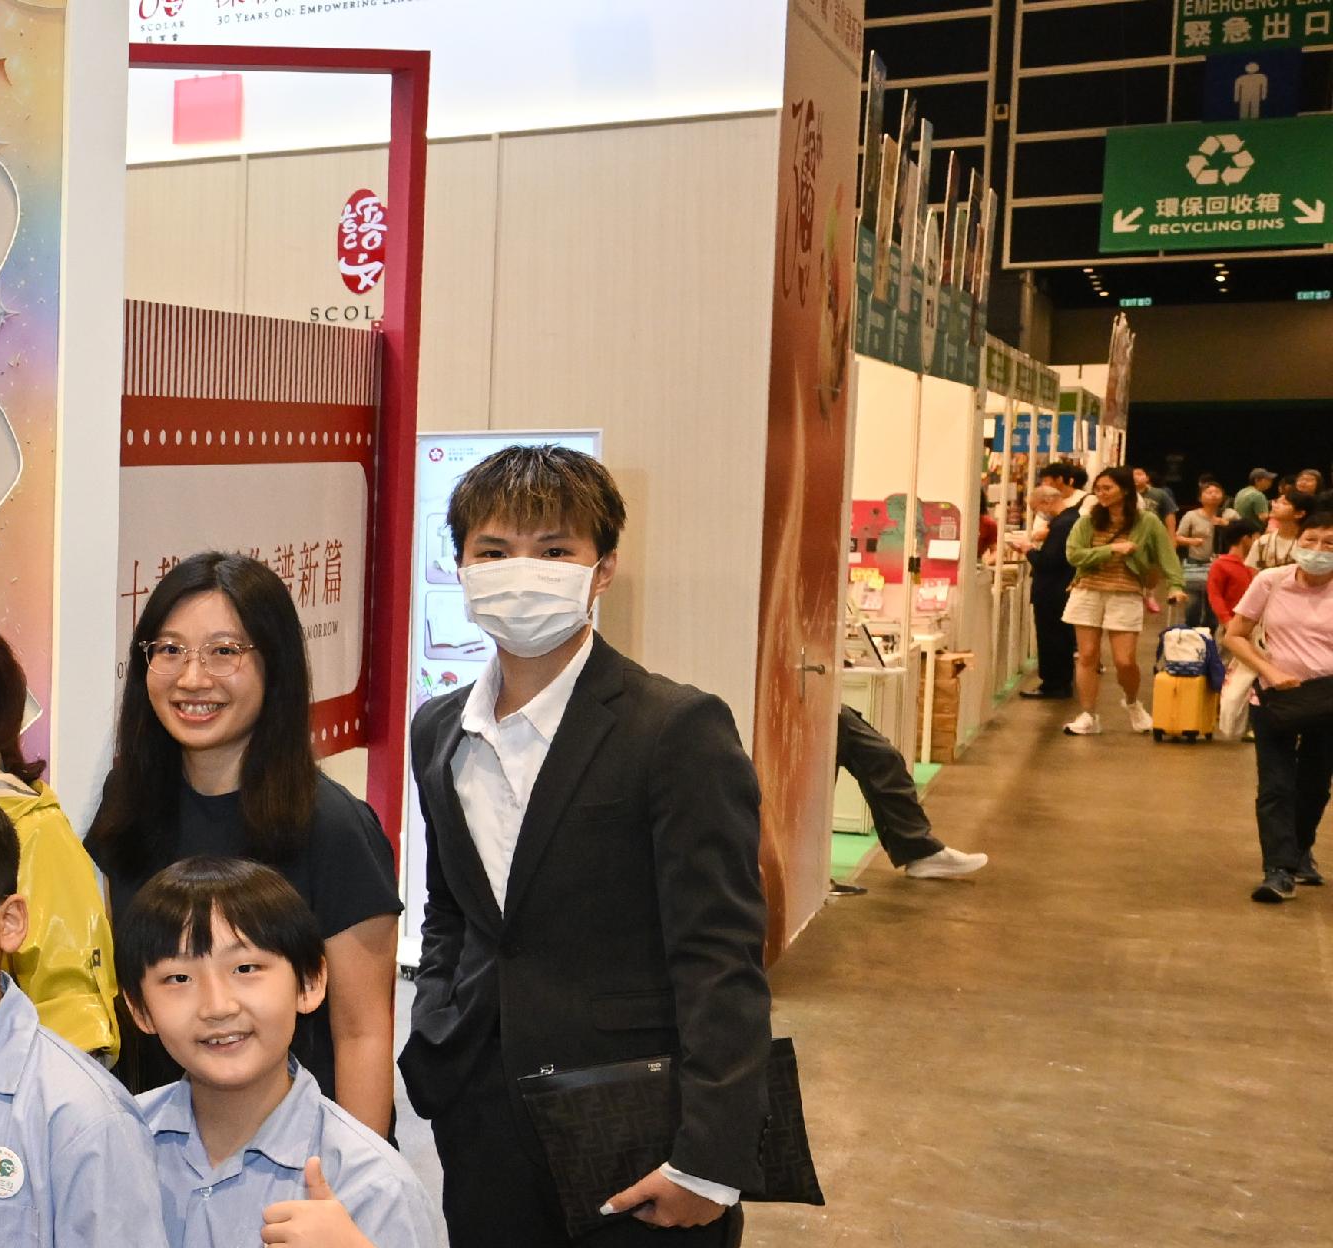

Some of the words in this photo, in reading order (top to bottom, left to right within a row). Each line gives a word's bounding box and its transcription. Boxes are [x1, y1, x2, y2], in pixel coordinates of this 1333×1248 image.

[1183, 11, 1330, 47] 緊急出口
[1156, 193, 1281, 218] 環保回收箱
[1149, 219, 1243, 235] RECYCLING
[1246, 217, 1286, 231] BINS
[310, 305, 384, 321] SCOL
